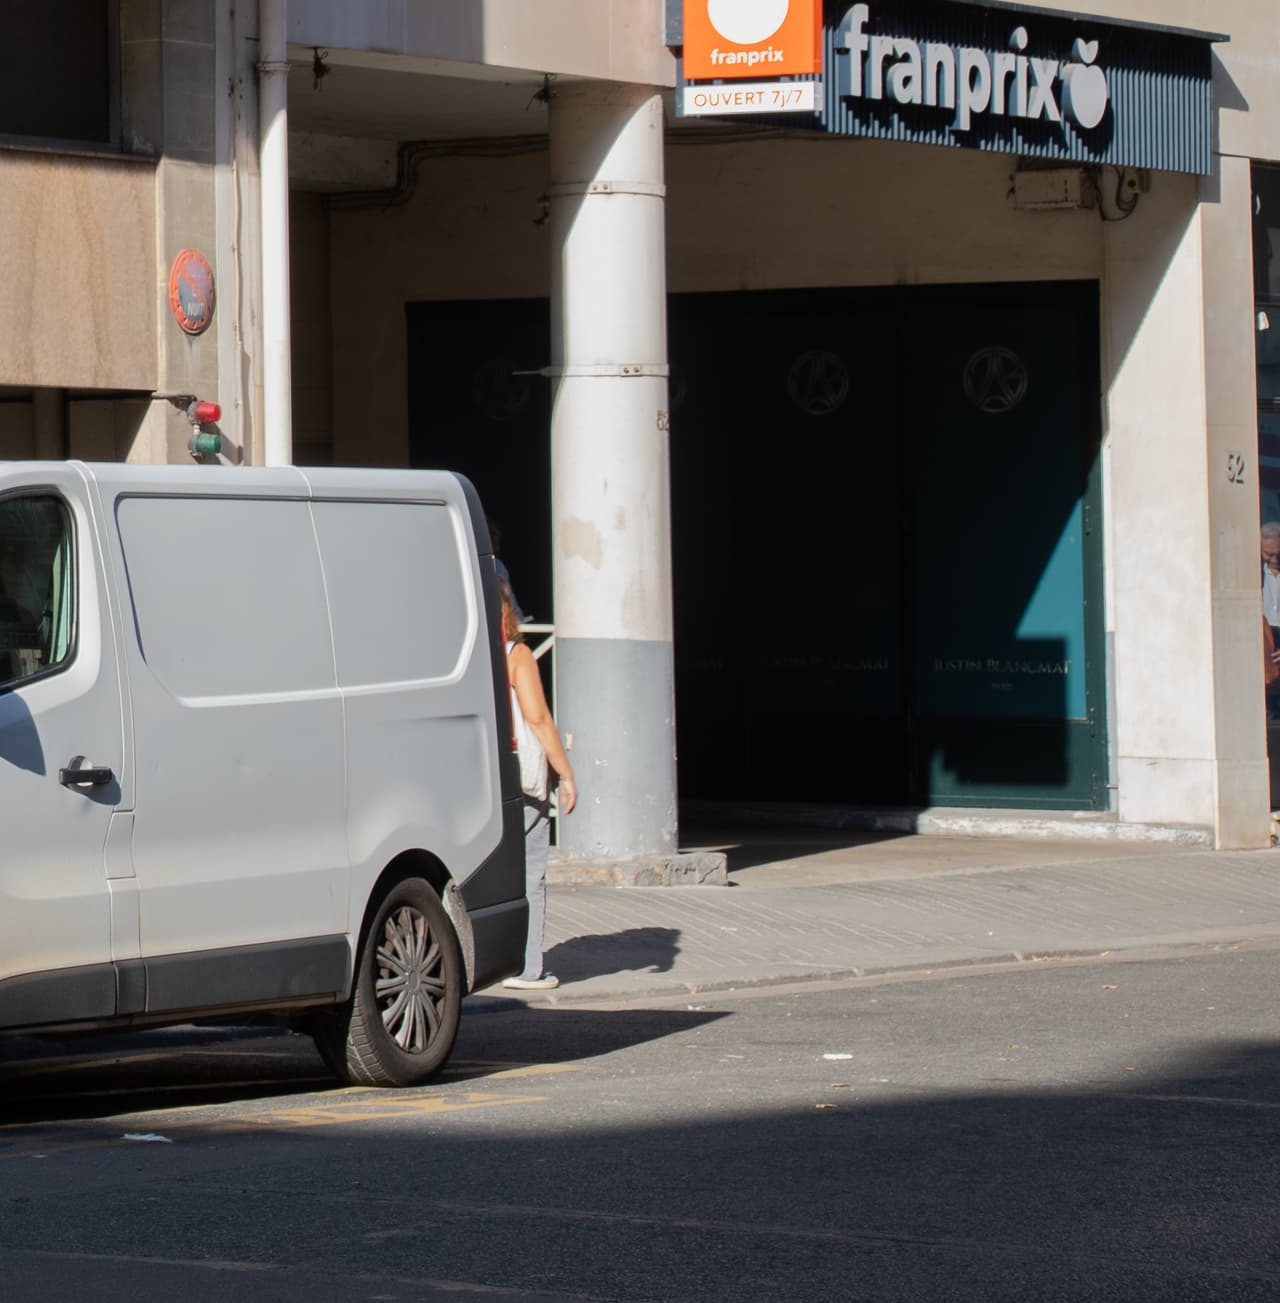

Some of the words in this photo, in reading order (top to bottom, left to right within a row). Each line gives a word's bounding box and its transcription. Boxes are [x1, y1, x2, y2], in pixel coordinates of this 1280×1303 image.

[710, 46, 784, 66] franprix
[838, 3, 1062, 131] franprix
[694, 91, 765, 107] OUVERT
[771, 89, 803, 107] 7j/7
[1226, 449, 1245, 485] 52
